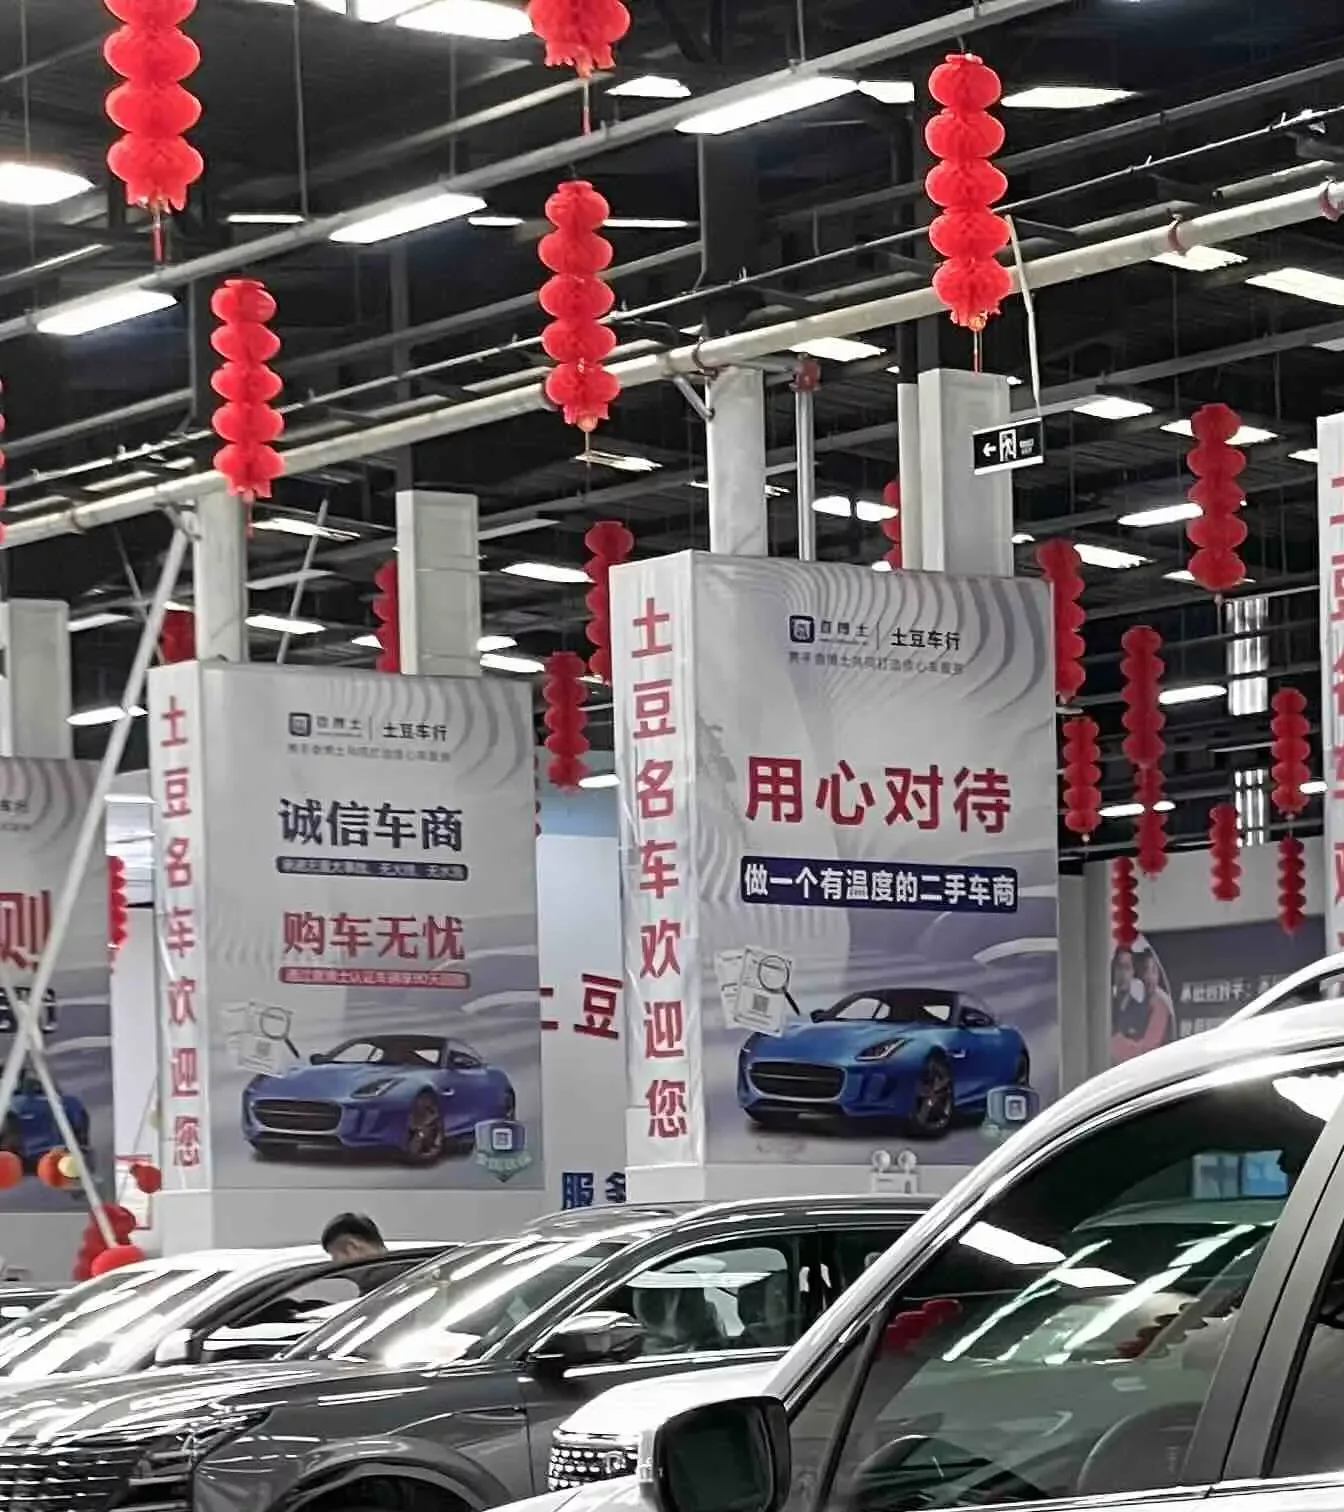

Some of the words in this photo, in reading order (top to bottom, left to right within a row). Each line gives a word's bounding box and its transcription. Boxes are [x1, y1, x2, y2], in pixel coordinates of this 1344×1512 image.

[891, 628, 961, 650] 土豆车行
[744, 756, 1012, 834] 用心对待
[278, 799, 463, 852] 诚信车商
[631, 597, 688, 1140] 土豆名车欢迎您
[743, 862, 1017, 908] 做一个有温度的二手车商
[160, 695, 202, 1168] 土豆名车欢迎您
[283, 911, 466, 960] 购车无忧
